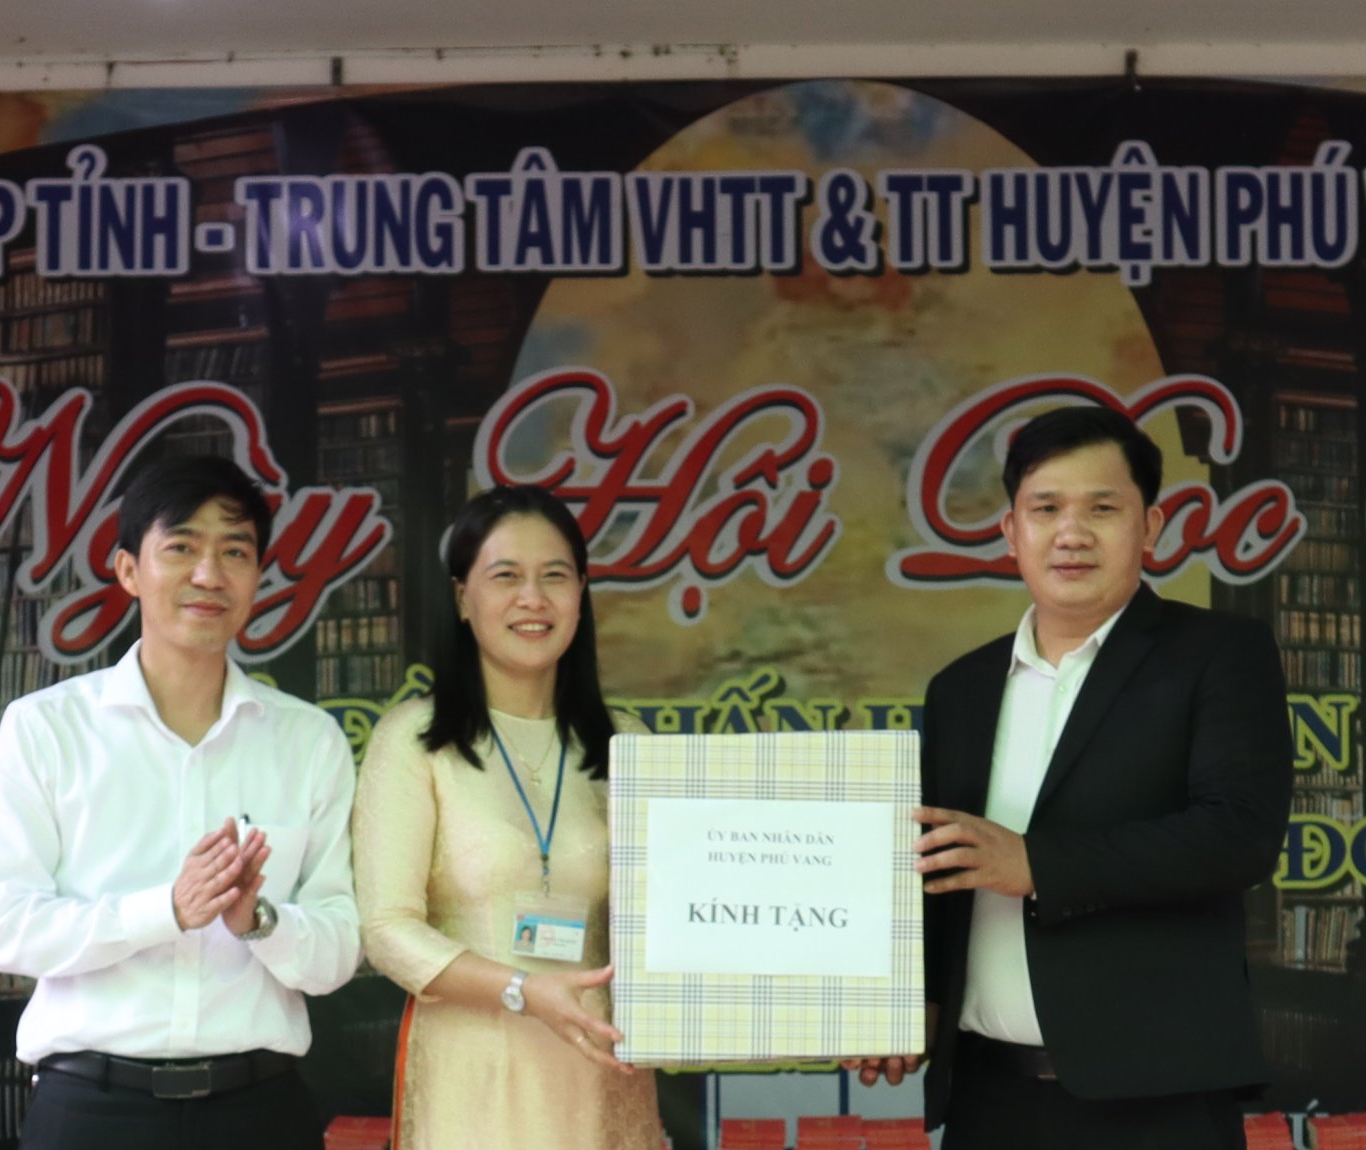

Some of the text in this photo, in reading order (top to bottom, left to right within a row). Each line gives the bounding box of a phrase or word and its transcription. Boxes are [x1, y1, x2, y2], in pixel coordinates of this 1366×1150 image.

[28, 145, 191, 276] TỈNH
[236, 170, 463, 274] TRUNG
[465, 147, 622, 272] TÂM
[626, 170, 805, 272] VHTT
[811, 168, 878, 271] &
[880, 170, 974, 271] TT
[982, 141, 1210, 285] HUYỆN
[1218, 141, 1359, 268] PHÚ
[441, 365, 841, 626] Hội
[730, 831, 758, 843] BAN
[793, 854, 833, 867] VANG
[688, 897, 849, 932] KÍNH TẶNG
